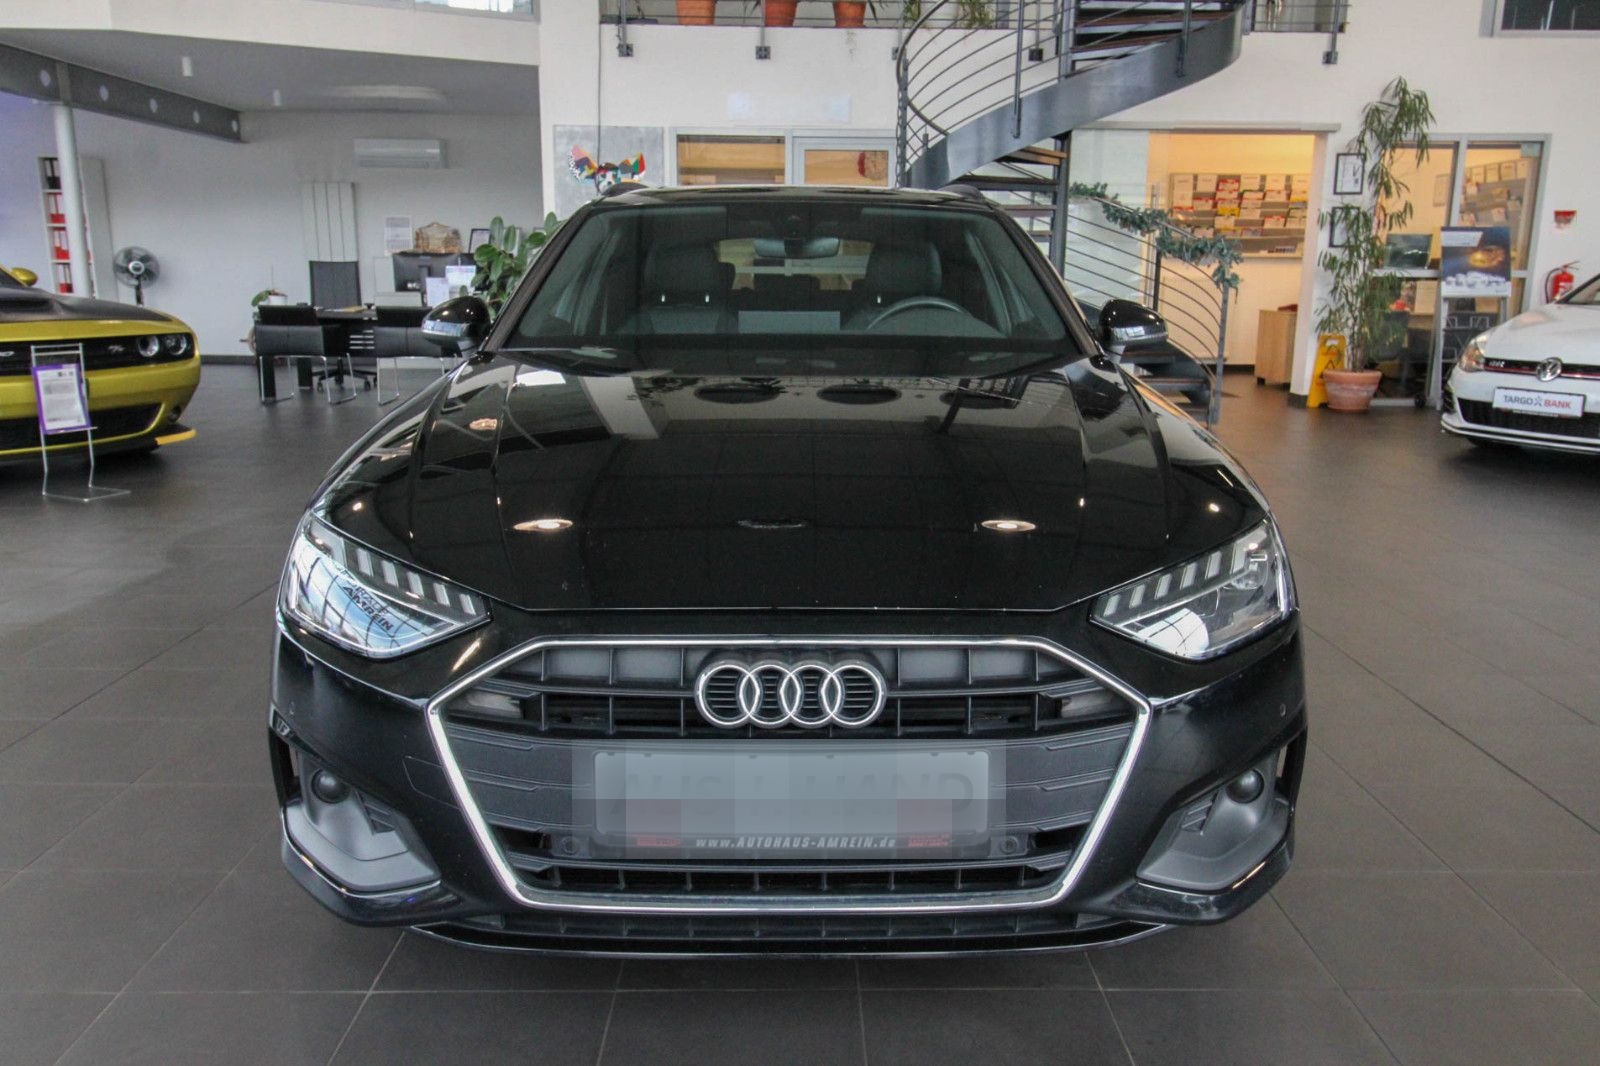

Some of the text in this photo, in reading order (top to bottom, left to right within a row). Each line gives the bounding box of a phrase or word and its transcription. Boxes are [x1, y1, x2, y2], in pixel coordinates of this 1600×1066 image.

[1503, 394, 1572, 409] TARGO BANK
[609, 773, 723, 816] AUS
[801, 772, 975, 816] HAND
[695, 836, 896, 848] www.AUTOHAUS-AMREIN.de
